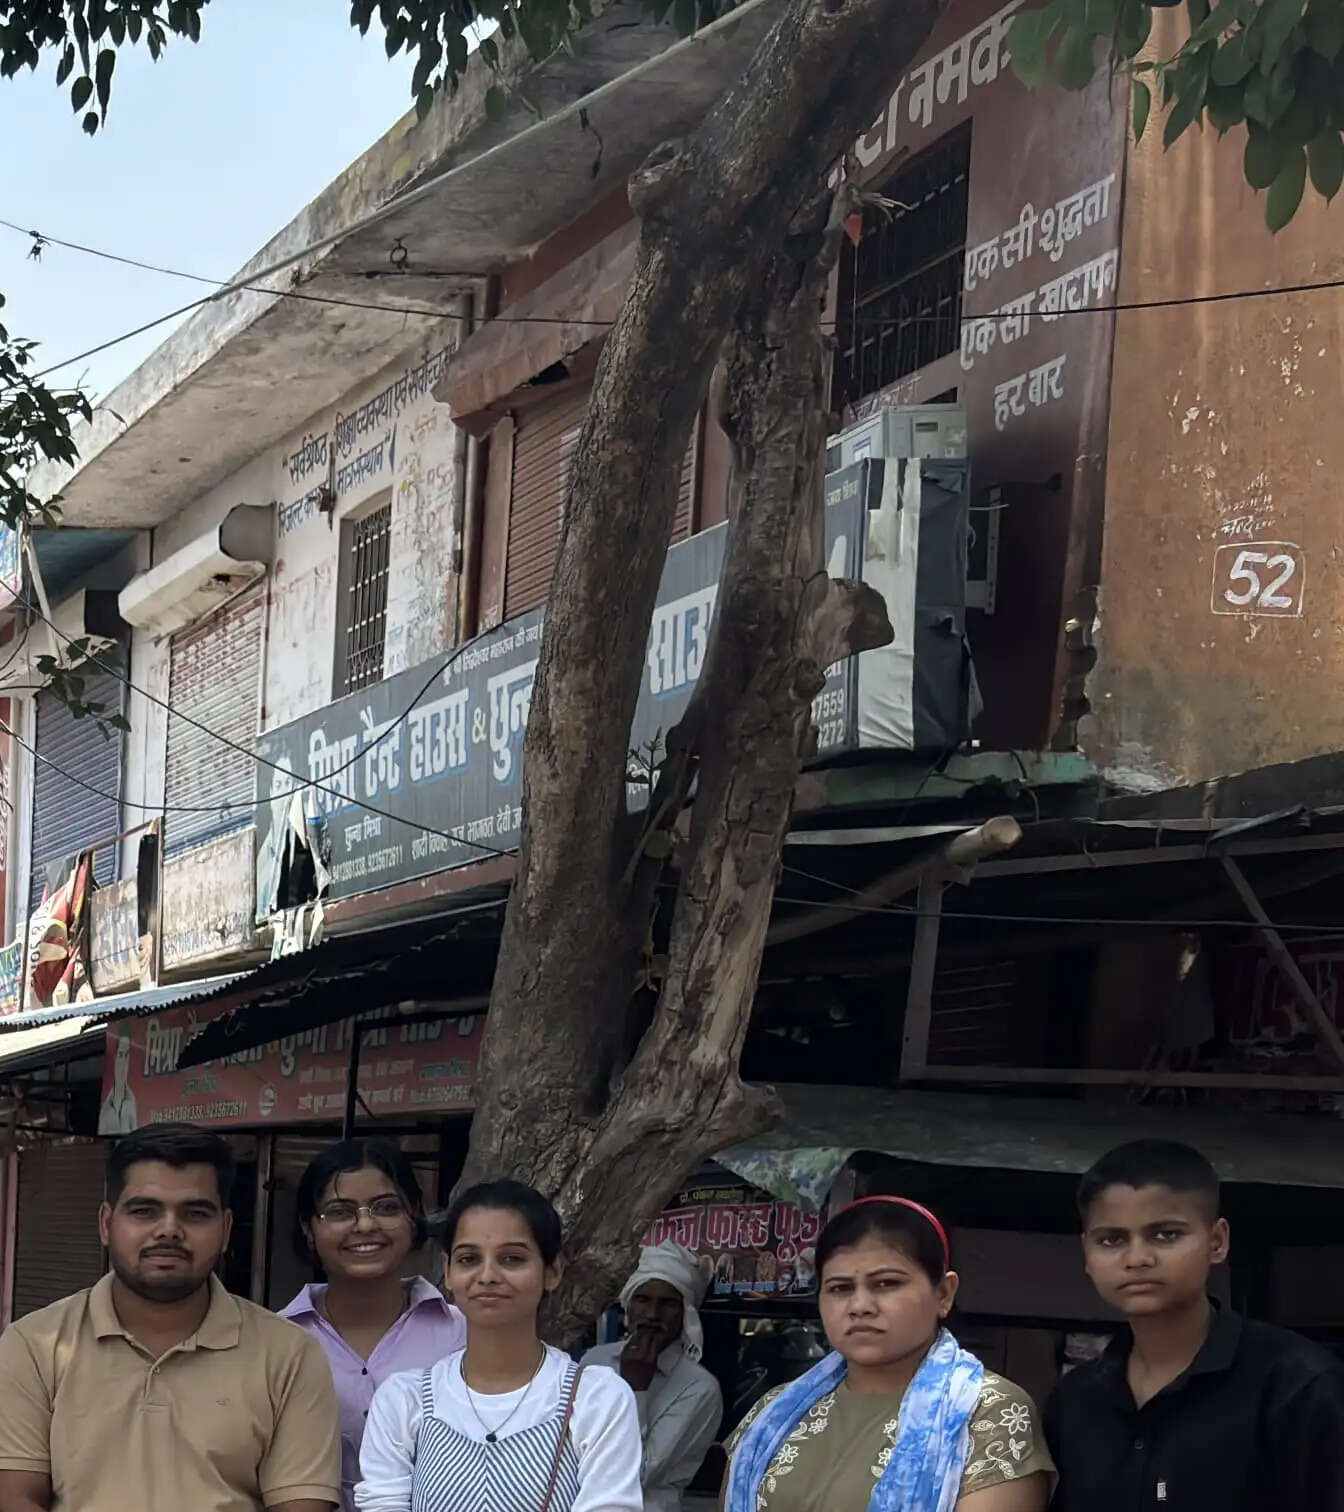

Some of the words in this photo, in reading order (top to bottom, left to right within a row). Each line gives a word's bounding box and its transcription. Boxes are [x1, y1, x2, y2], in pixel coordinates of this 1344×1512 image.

[965, 237, 999, 291] एक
[1002, 202, 1038, 268] सी
[1039, 174, 1115, 262] शुद्धता
[994, 374, 1026, 431] हर
[1029, 354, 1066, 406] बार
[1224, 551, 1296, 609] 52
[408, 687, 470, 783] हाउस
[473, 707, 487, 744] &
